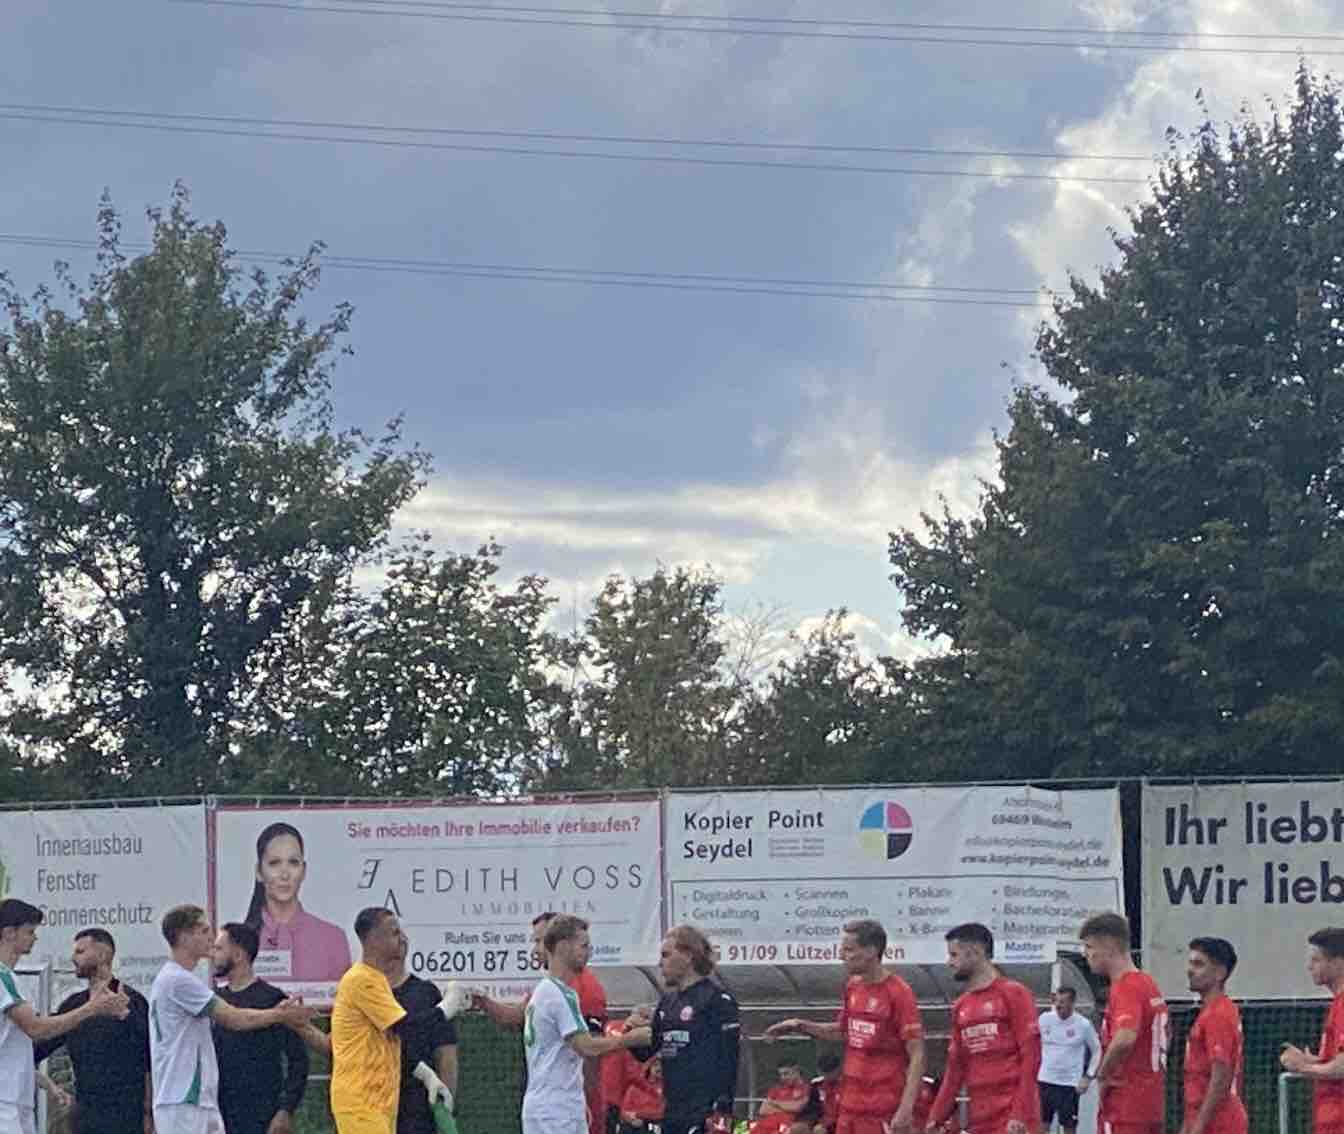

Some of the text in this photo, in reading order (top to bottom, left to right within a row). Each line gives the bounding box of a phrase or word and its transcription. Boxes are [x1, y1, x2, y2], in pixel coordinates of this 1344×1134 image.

[347, 815, 642, 839] Sie möchten Ihre Immobilie verkaufen?
[683, 809, 825, 835] Kopier Point
[1163, 802, 1227, 846] Ihr
[35, 831, 143, 857] Innenausbau
[682, 838, 753, 863] Seydel
[37, 868, 98, 893] Fenster
[411, 862, 643, 894] EDITH VOSS
[1163, 864, 1248, 906] Wir
[40, 901, 154, 927] Sonnenschutz
[460, 899, 597, 917] IMMOBILIEN
[482, 931, 501, 946] Sie
[504, 932, 526, 944] uns
[411, 950, 476, 973] 06201
[483, 950, 508, 972] 87
[727, 945, 778, 961] 91/09
